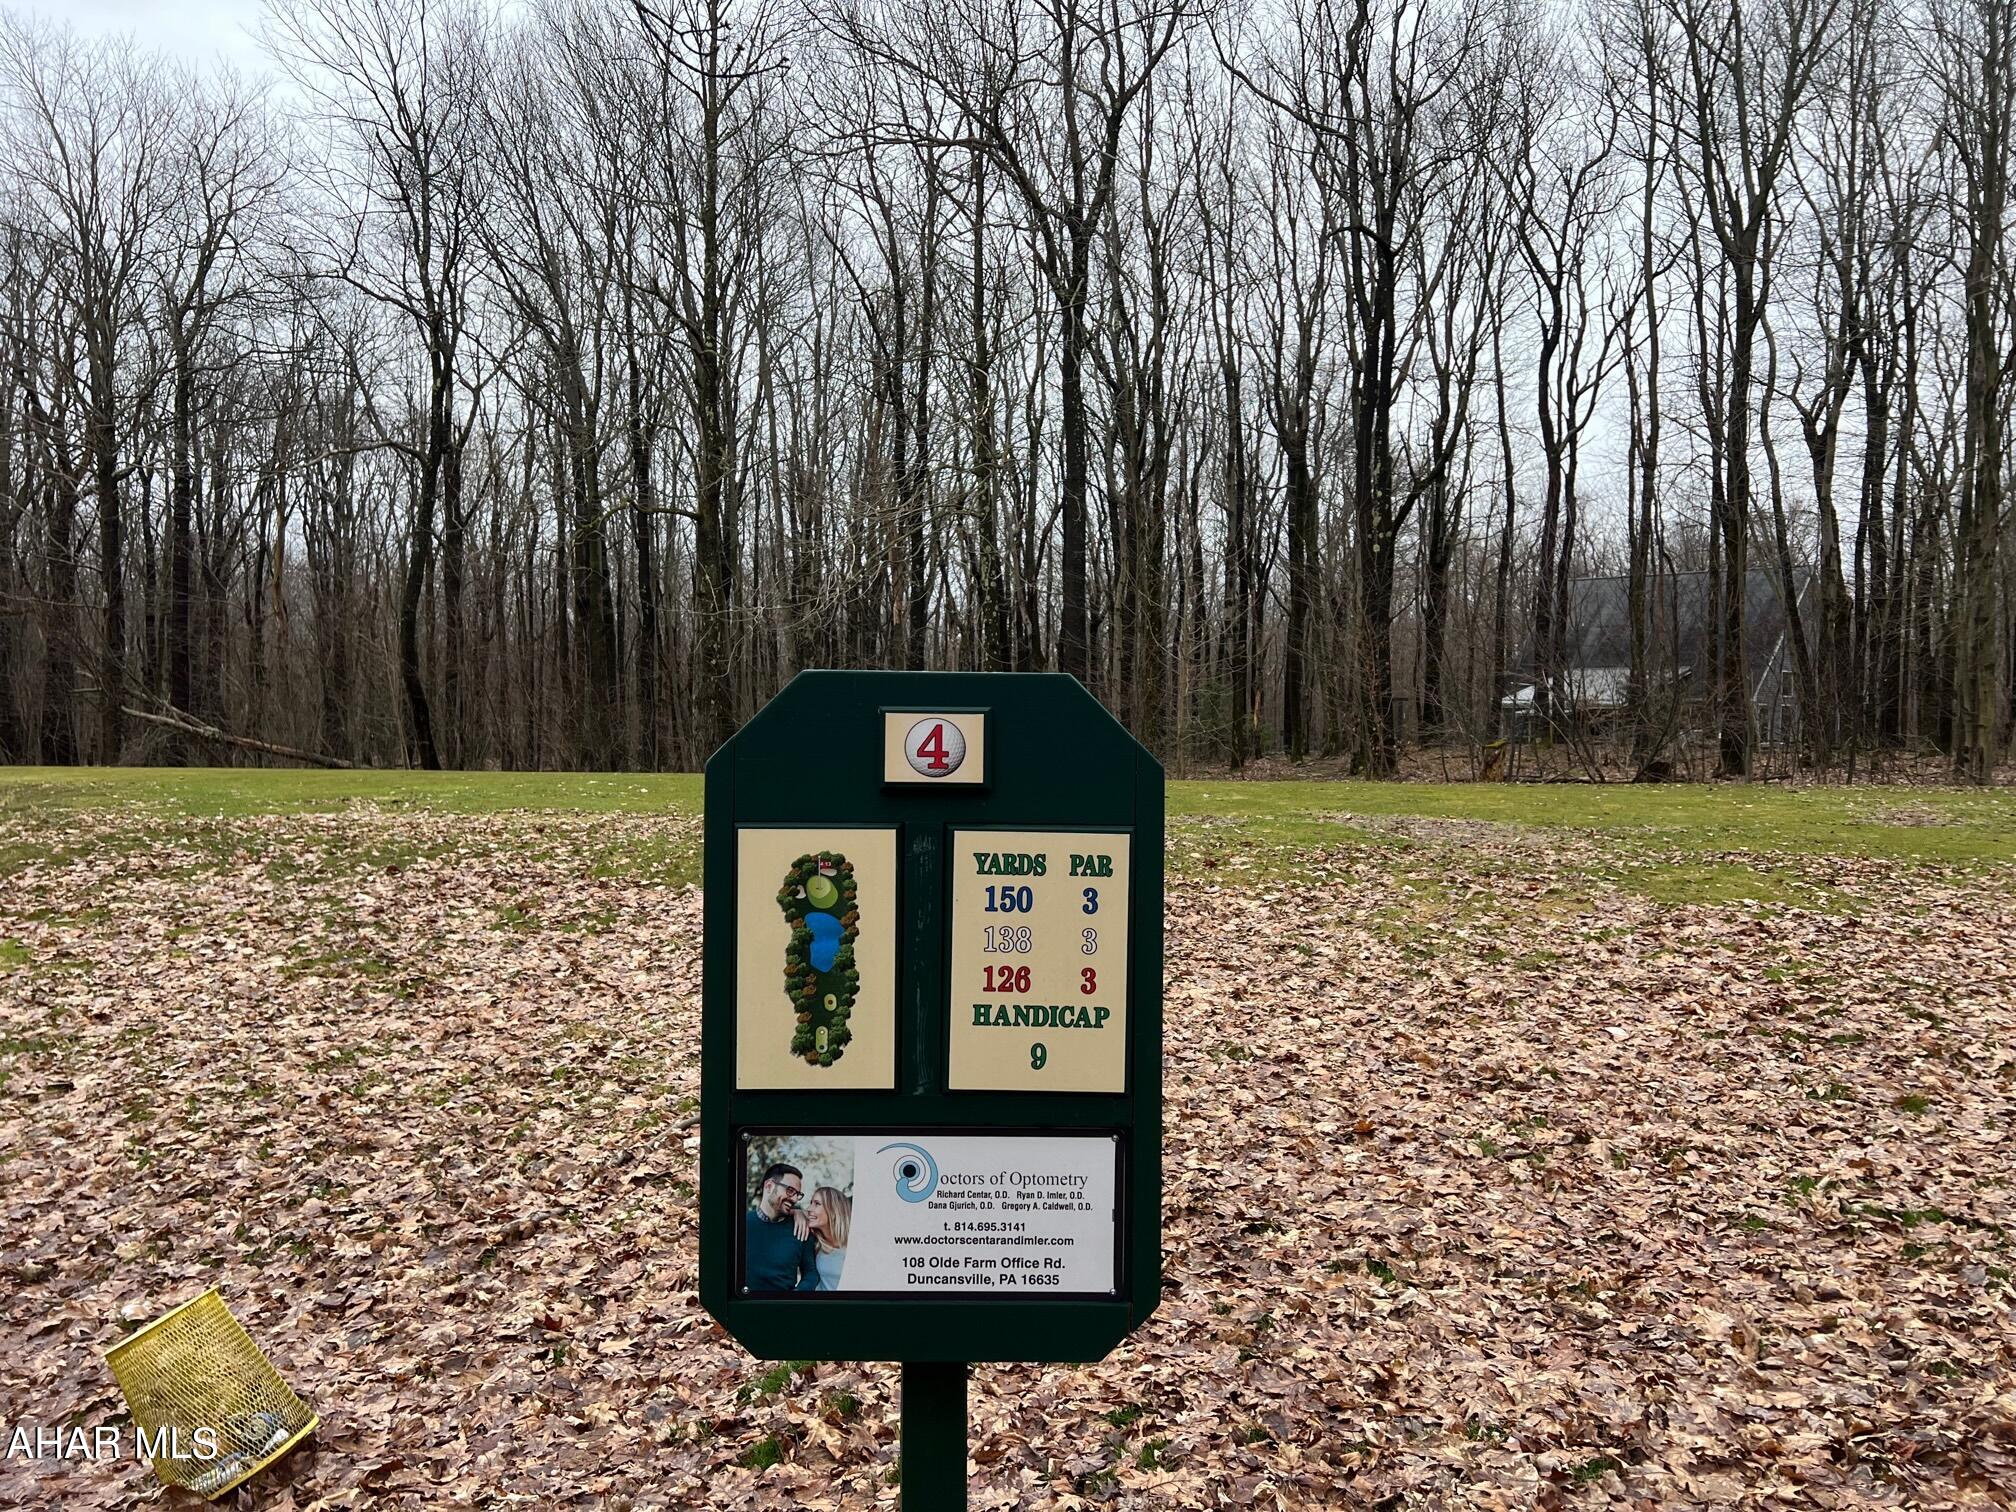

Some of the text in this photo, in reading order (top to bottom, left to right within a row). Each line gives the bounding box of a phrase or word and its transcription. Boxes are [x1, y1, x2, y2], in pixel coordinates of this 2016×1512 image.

[916, 723, 950, 769] 4
[973, 852, 1114, 877] YARDS PAR
[984, 885, 1099, 914] 150 3
[983, 925, 1098, 955] 138 3
[982, 965, 1097, 995] 126 3
[972, 1004, 1110, 1028] HANDICAP
[1030, 1042, 1047, 1070] 9
[989, 1171, 1007, 1185] of
[1009, 1171, 1088, 1189] Optometry
[936, 1190, 1085, 1200] Richard Centar, O.D. Ryan D. Imler, O.D.
[928, 1201, 1093, 1211] Dana Gjurich, O.D. Gregory A. Caldwell, O.D.
[944, 1222, 1026, 1232] t. 814.695.3141
[894, 1235, 1075, 1246] www.doctorscentarandimler.com
[902, 1257, 1066, 1269] 108 Olde Farm Office Rd.
[907, 1273, 1060, 1286] Duncansville, PA 16635
